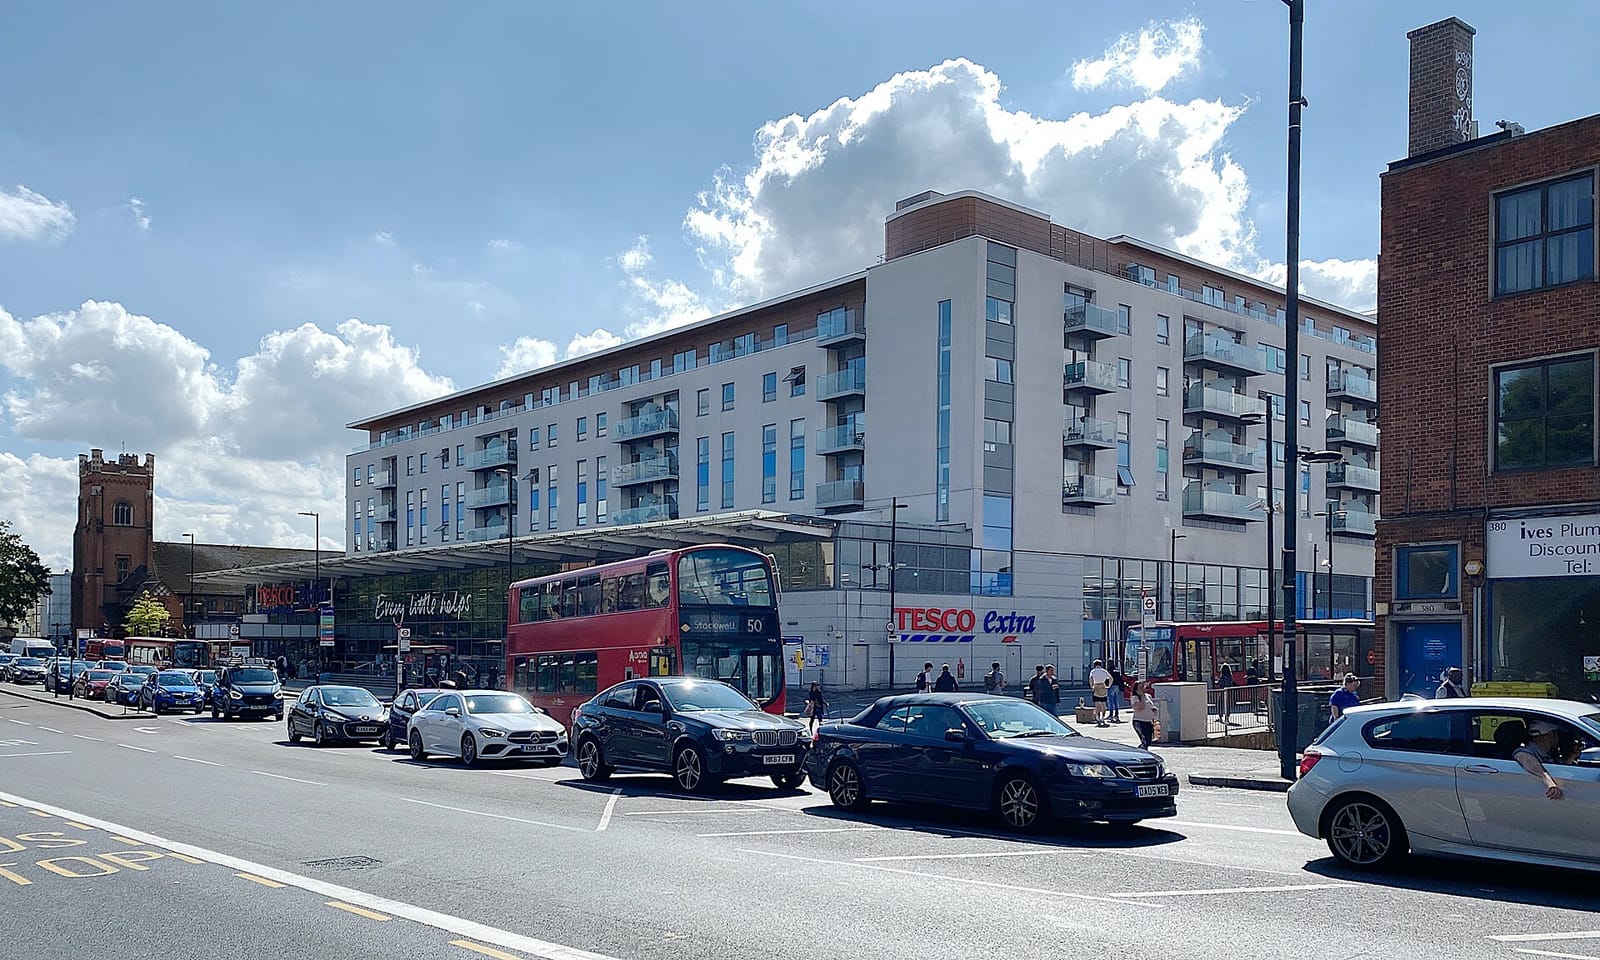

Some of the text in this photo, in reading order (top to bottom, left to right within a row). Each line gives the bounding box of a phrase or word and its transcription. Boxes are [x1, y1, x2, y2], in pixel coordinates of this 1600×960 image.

[1489, 522, 1507, 532] 380
[1520, 521, 1553, 540] ives
[1563, 559, 1592, 574] Tel:
[257, 585, 294, 606] TESCO
[409, 593, 437, 616] little
[439, 590, 472, 620] helps
[747, 619, 762, 633] 50
[894, 607, 1036, 634] TESCO extra
